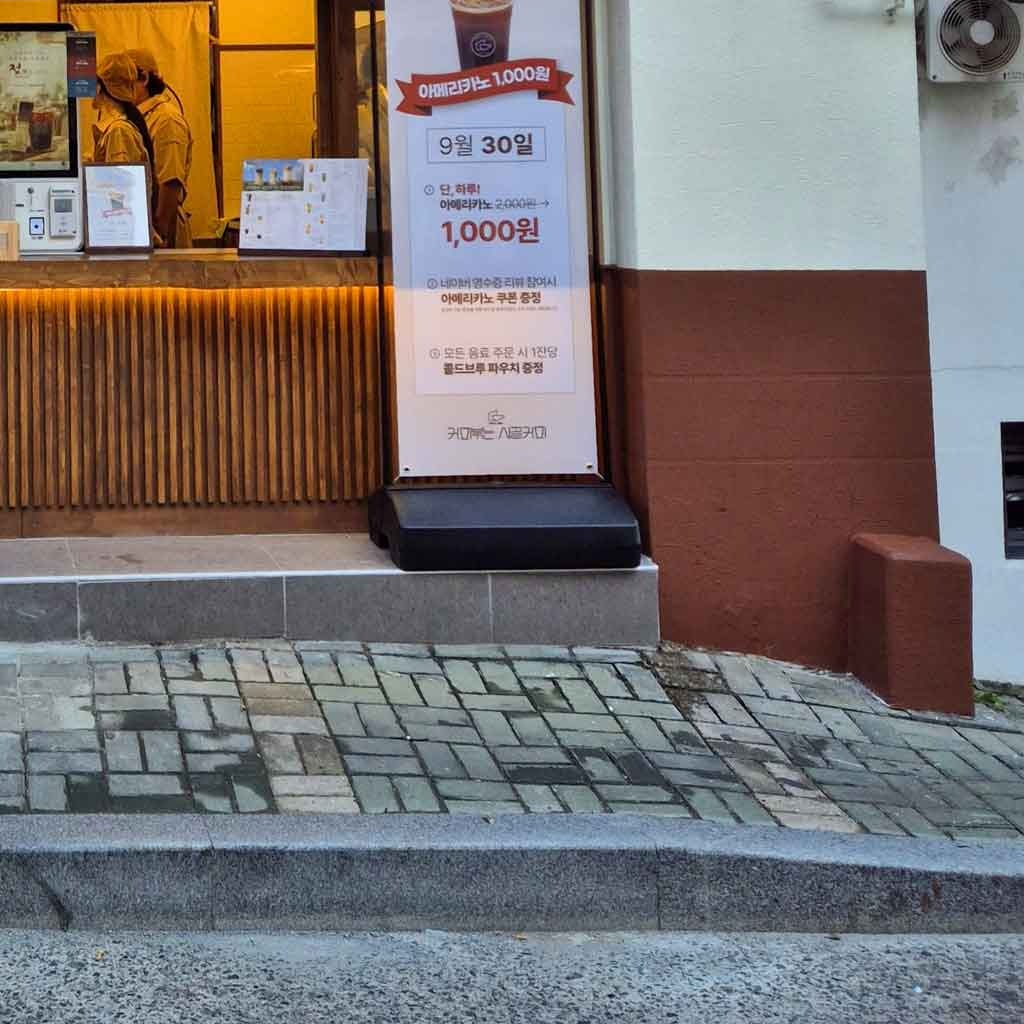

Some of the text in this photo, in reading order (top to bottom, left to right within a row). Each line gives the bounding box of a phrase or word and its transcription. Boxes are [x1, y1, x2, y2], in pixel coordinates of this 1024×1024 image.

[418, 75, 493, 99] 아메리카노
[439, 133, 534, 157] 9월 30일
[455, 183, 481, 196] 하루!
[439, 198, 493, 212] 아메리카노
[440, 216, 540, 248] 1,000원
[440, 277, 472, 291] 네이버
[440, 291, 542, 305] 아메리카노 쿠폰 증정
[443, 347, 466, 360] 모든
[468, 347, 490, 360] 음료
[493, 347, 514, 360] 주문
[488, 362, 521, 375] 파우치
[522, 361, 544, 374] 증정
